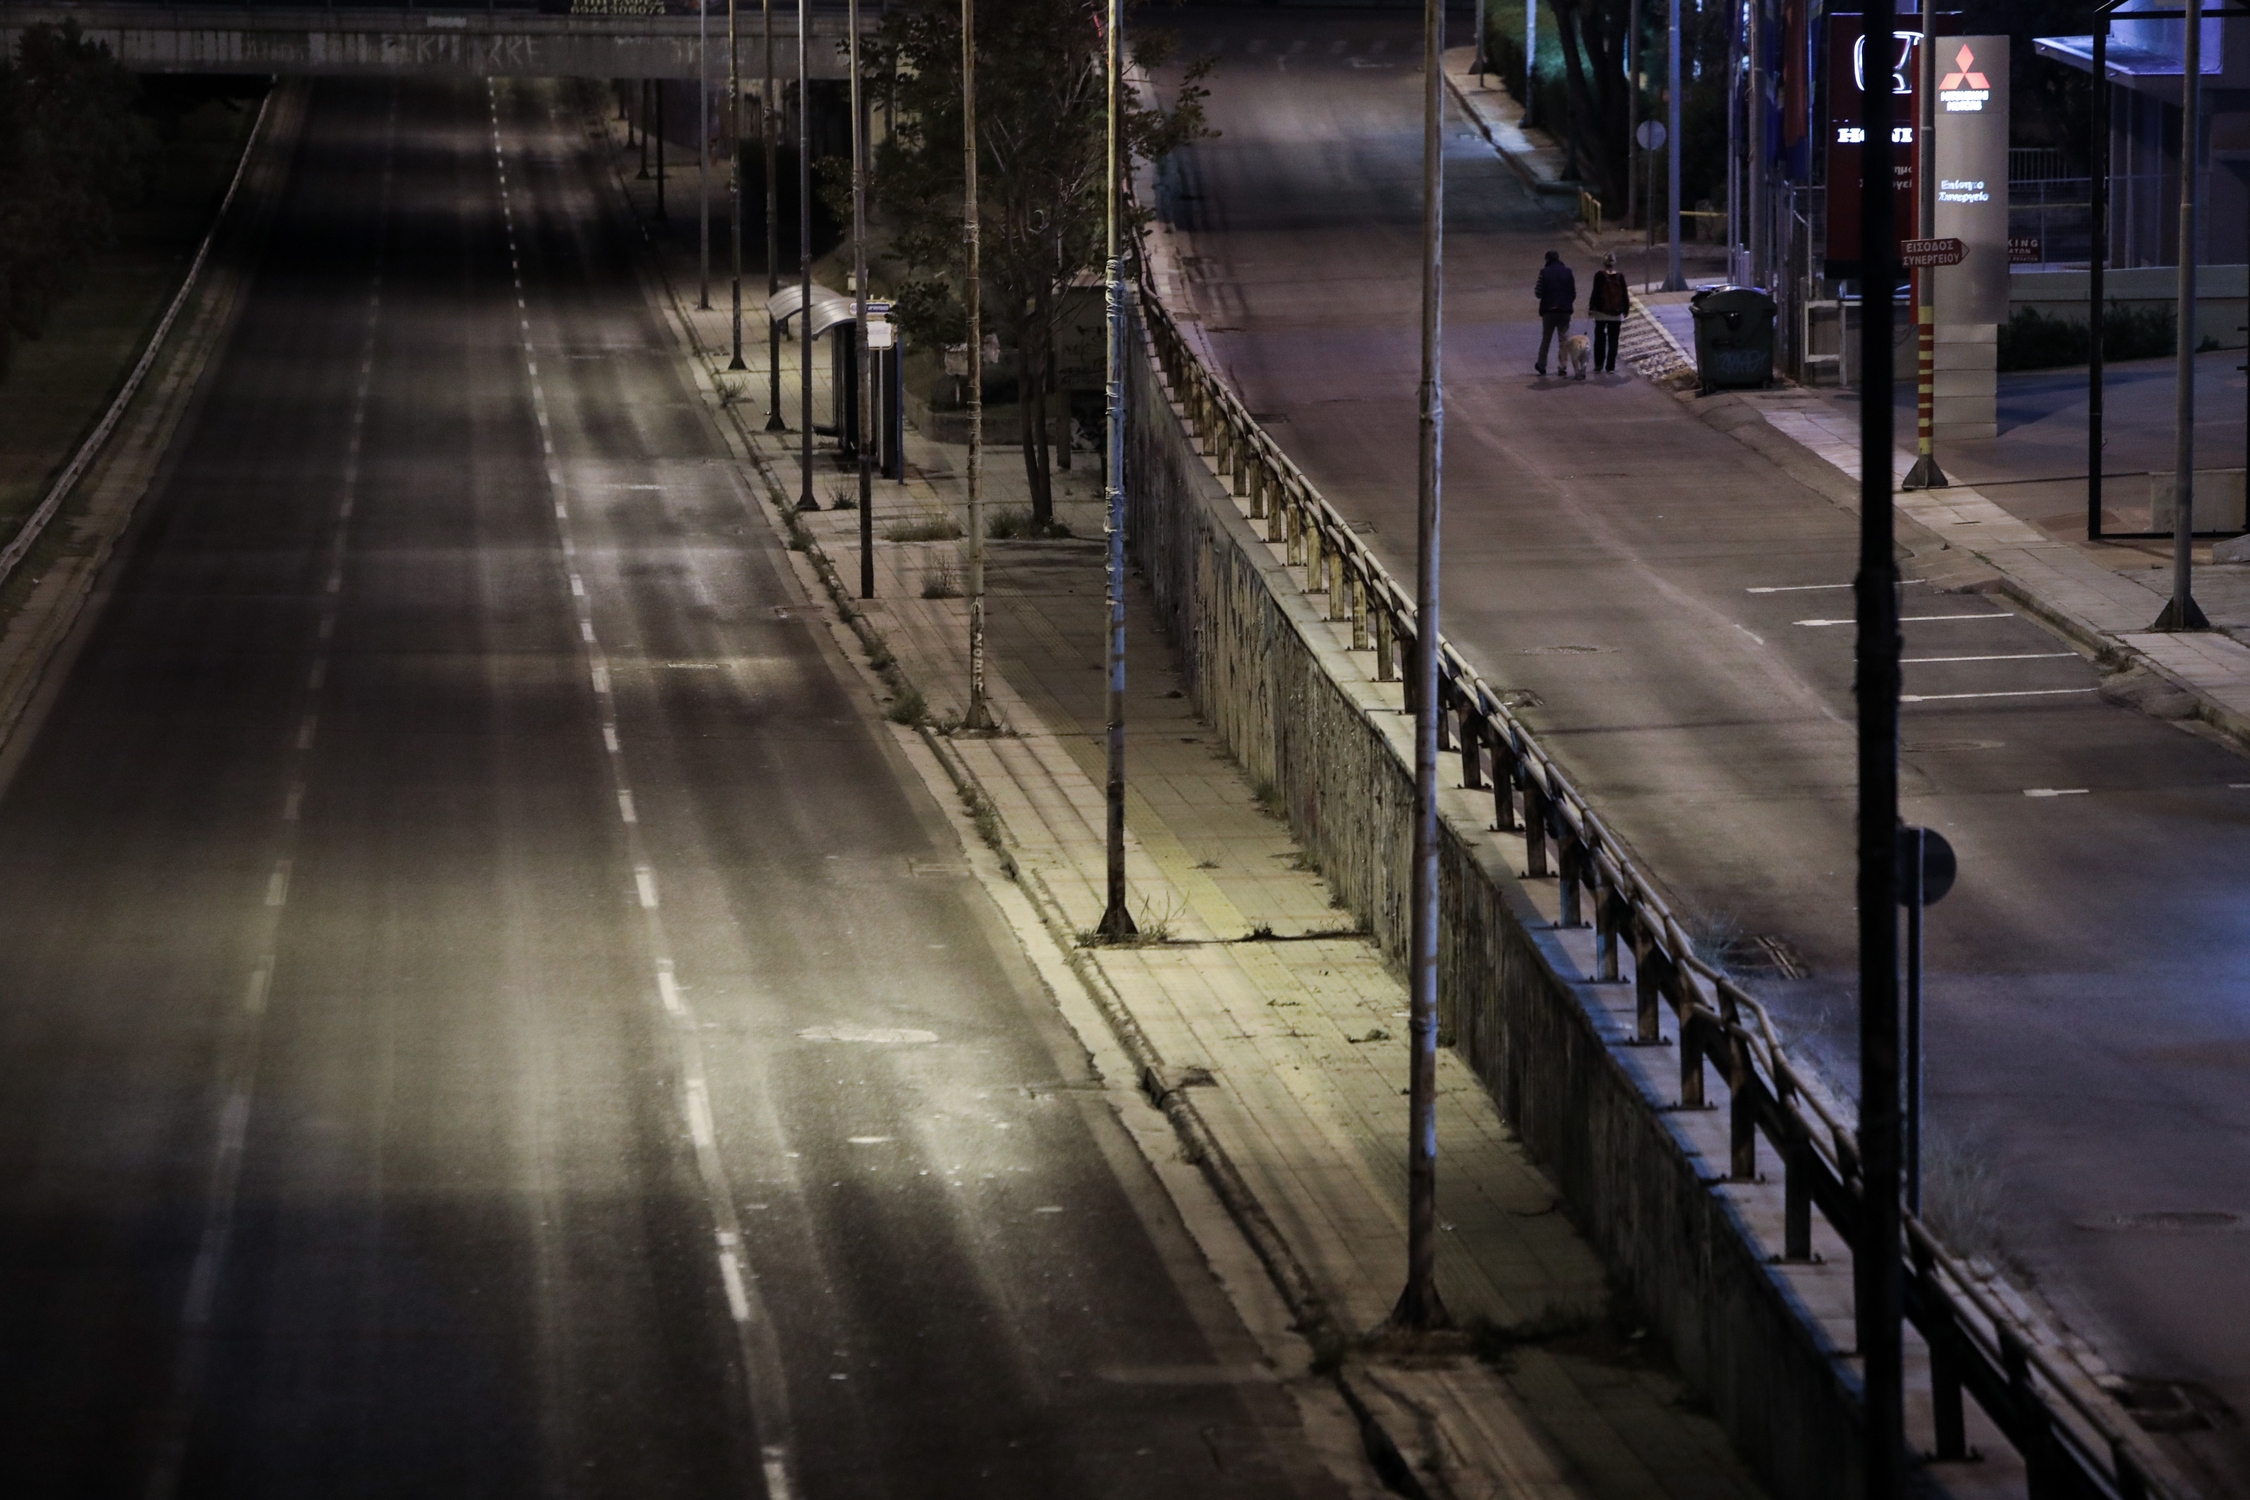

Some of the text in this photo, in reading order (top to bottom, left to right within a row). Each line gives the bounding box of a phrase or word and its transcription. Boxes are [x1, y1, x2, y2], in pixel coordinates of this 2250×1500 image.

[1906, 240, 1954, 253] ΕΙΣΟΔΟΣ
[2008, 239, 2038, 248] KING
[1902, 253, 1960, 266] ΣΥΝΕΡΓΕΙΟΥ
